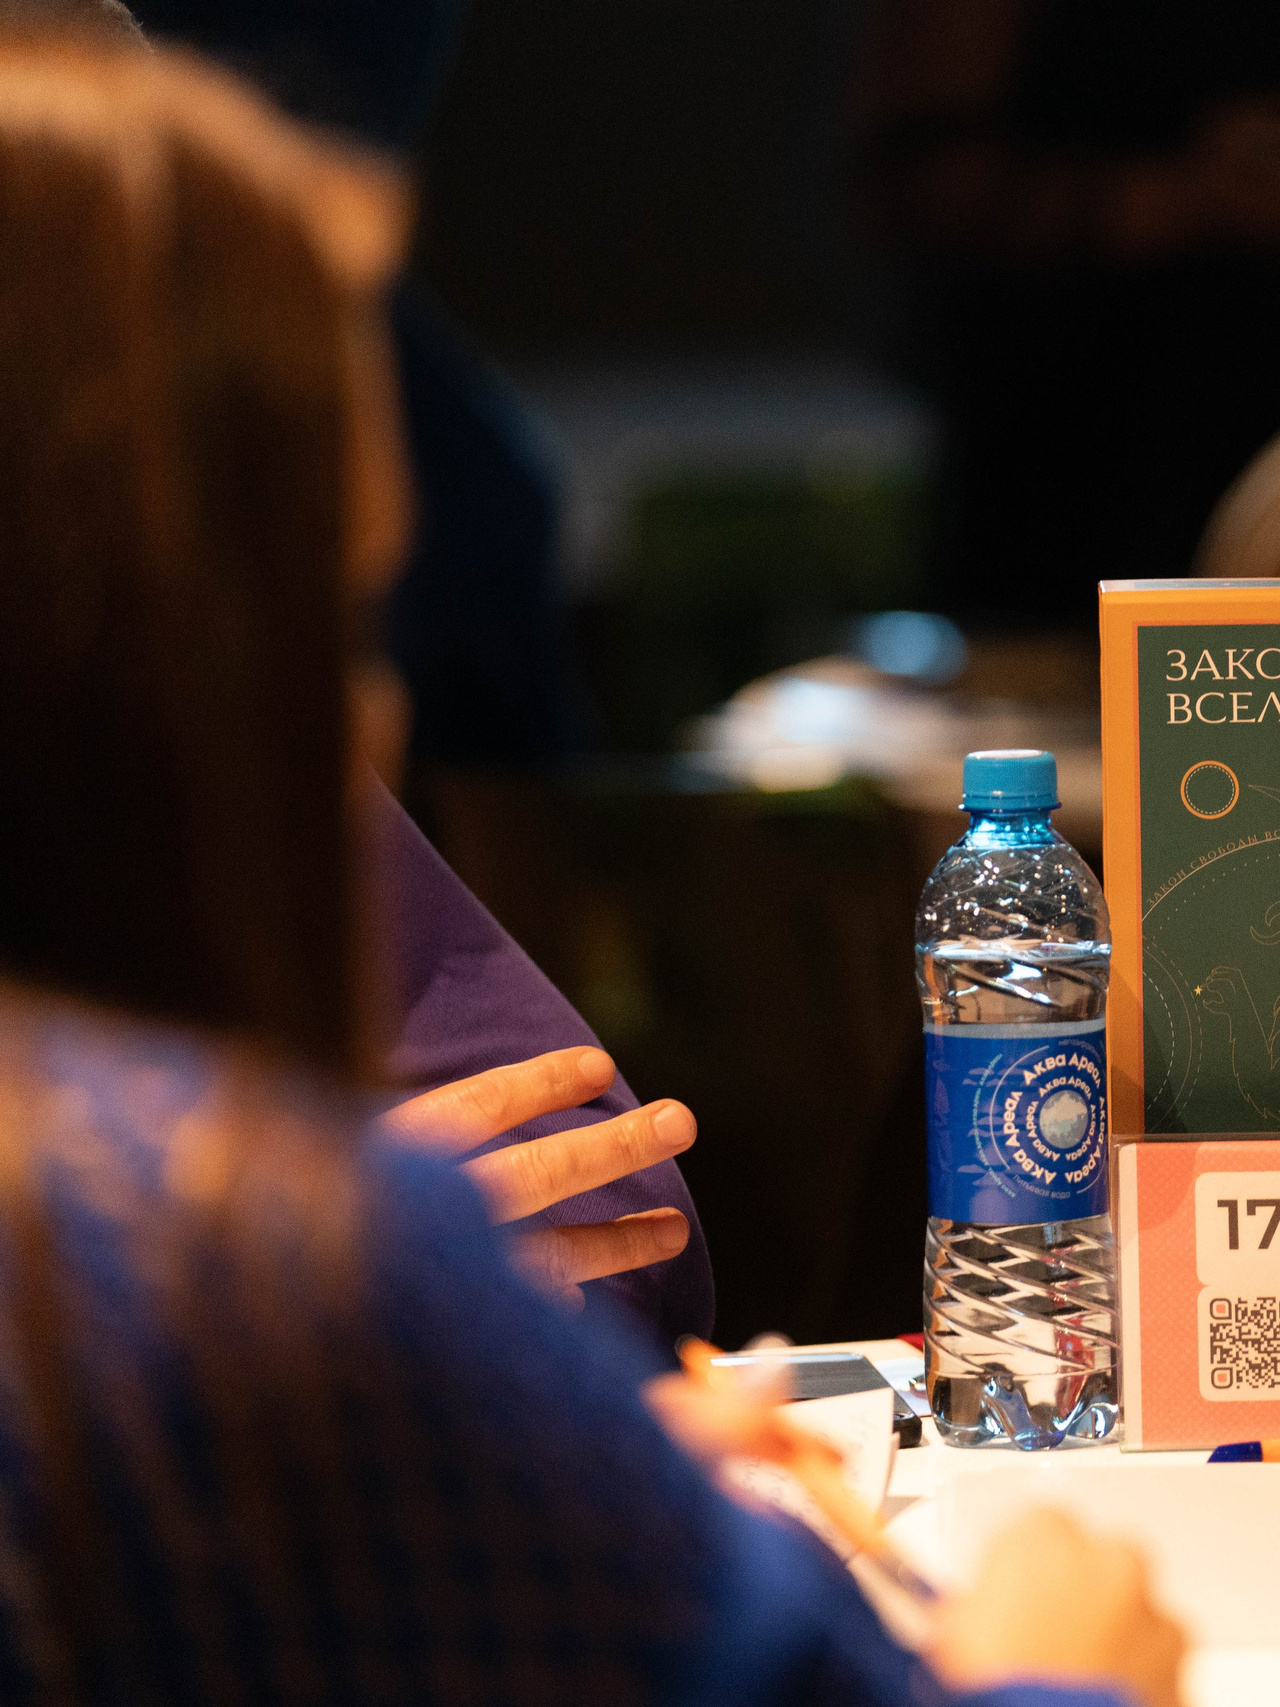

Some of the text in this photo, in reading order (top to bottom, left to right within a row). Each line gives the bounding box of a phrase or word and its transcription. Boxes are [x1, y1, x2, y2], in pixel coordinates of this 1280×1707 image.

[1147, 869, 1187, 907] ЗАКОН
[1190, 834, 1258, 870] СВОБОДЫ
[1023, 1052, 1101, 1089] Аква Ареал
[1039, 1076, 1092, 1100] Аква Ареал
[1003, 1091, 1057, 1185] Аква Ареал
[1026, 1100, 1061, 1162] Аква Ареал
[1064, 1146, 1101, 1183] Ареал
